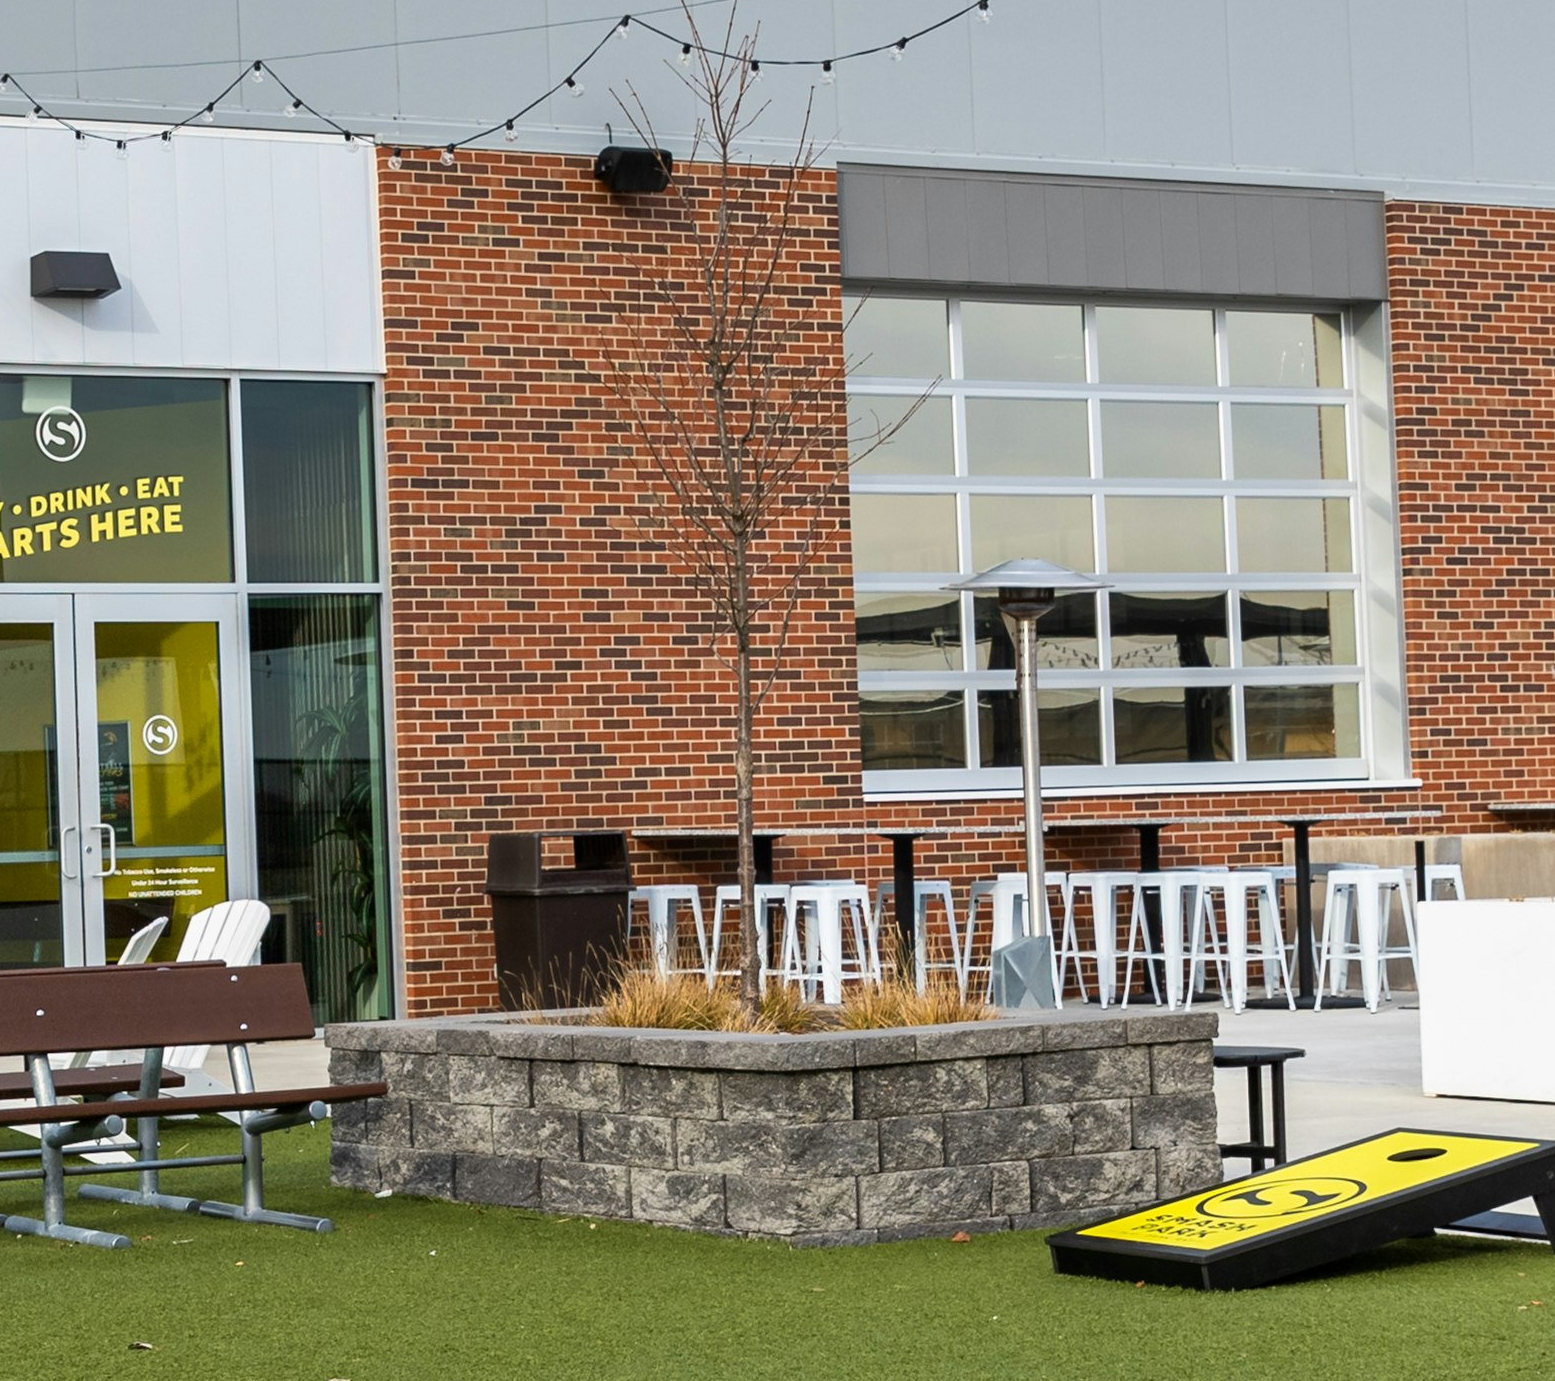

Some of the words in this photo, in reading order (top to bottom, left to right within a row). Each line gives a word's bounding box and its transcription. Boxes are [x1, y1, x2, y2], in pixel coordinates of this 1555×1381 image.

[30, 483, 112, 517] DRINK
[136, 476, 184, 499] EAT
[90, 504, 184, 543] HERE
[1131, 1223, 1219, 1238] PARK
[1146, 1214, 1258, 1232] SMASH
